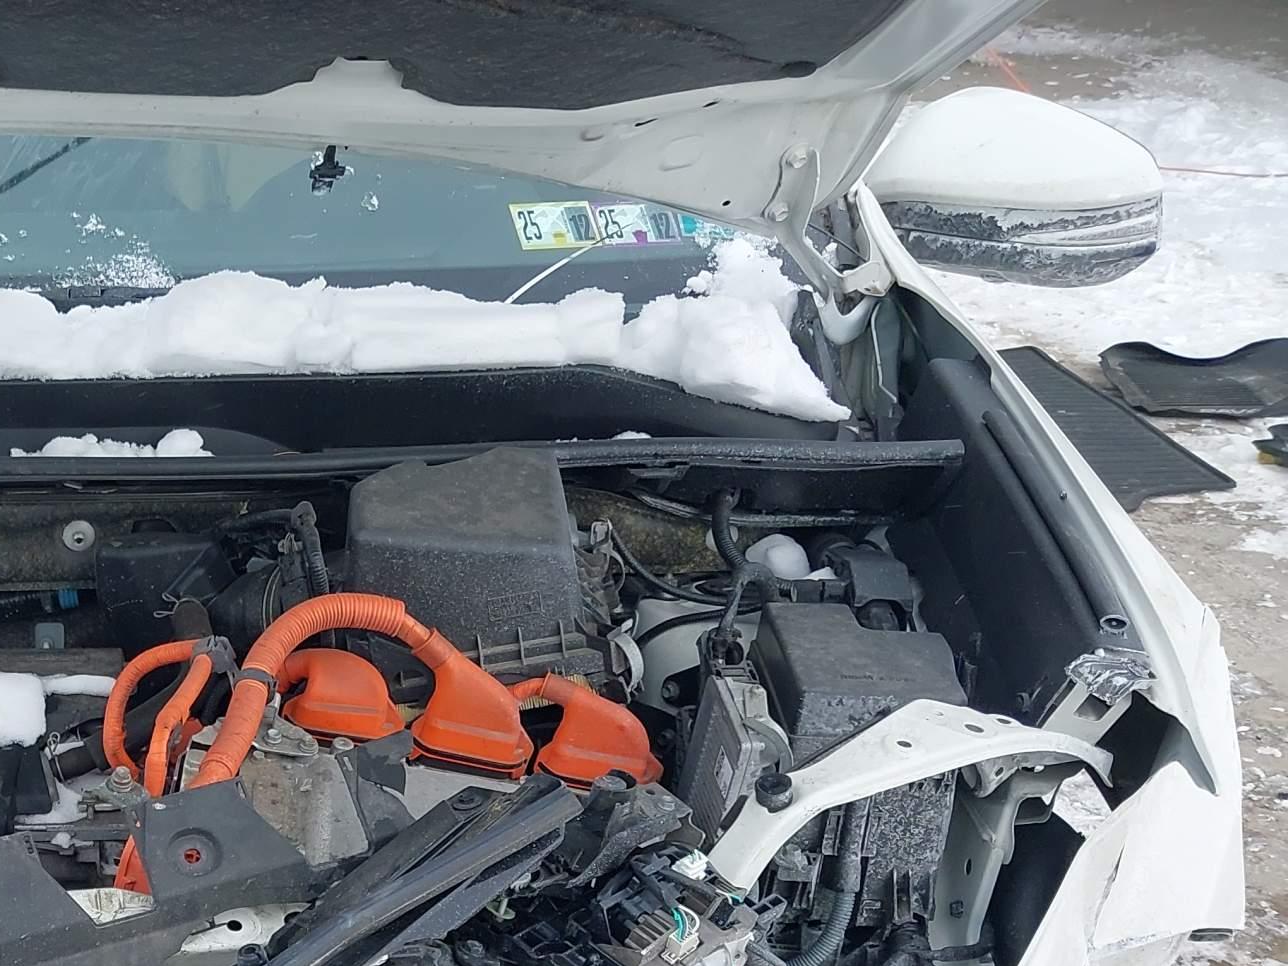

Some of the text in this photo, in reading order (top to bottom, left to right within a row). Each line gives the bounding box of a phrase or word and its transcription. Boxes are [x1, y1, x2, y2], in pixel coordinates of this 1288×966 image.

[517, 210, 596, 241] 25 12
[598, 209, 677, 239] 25 12
